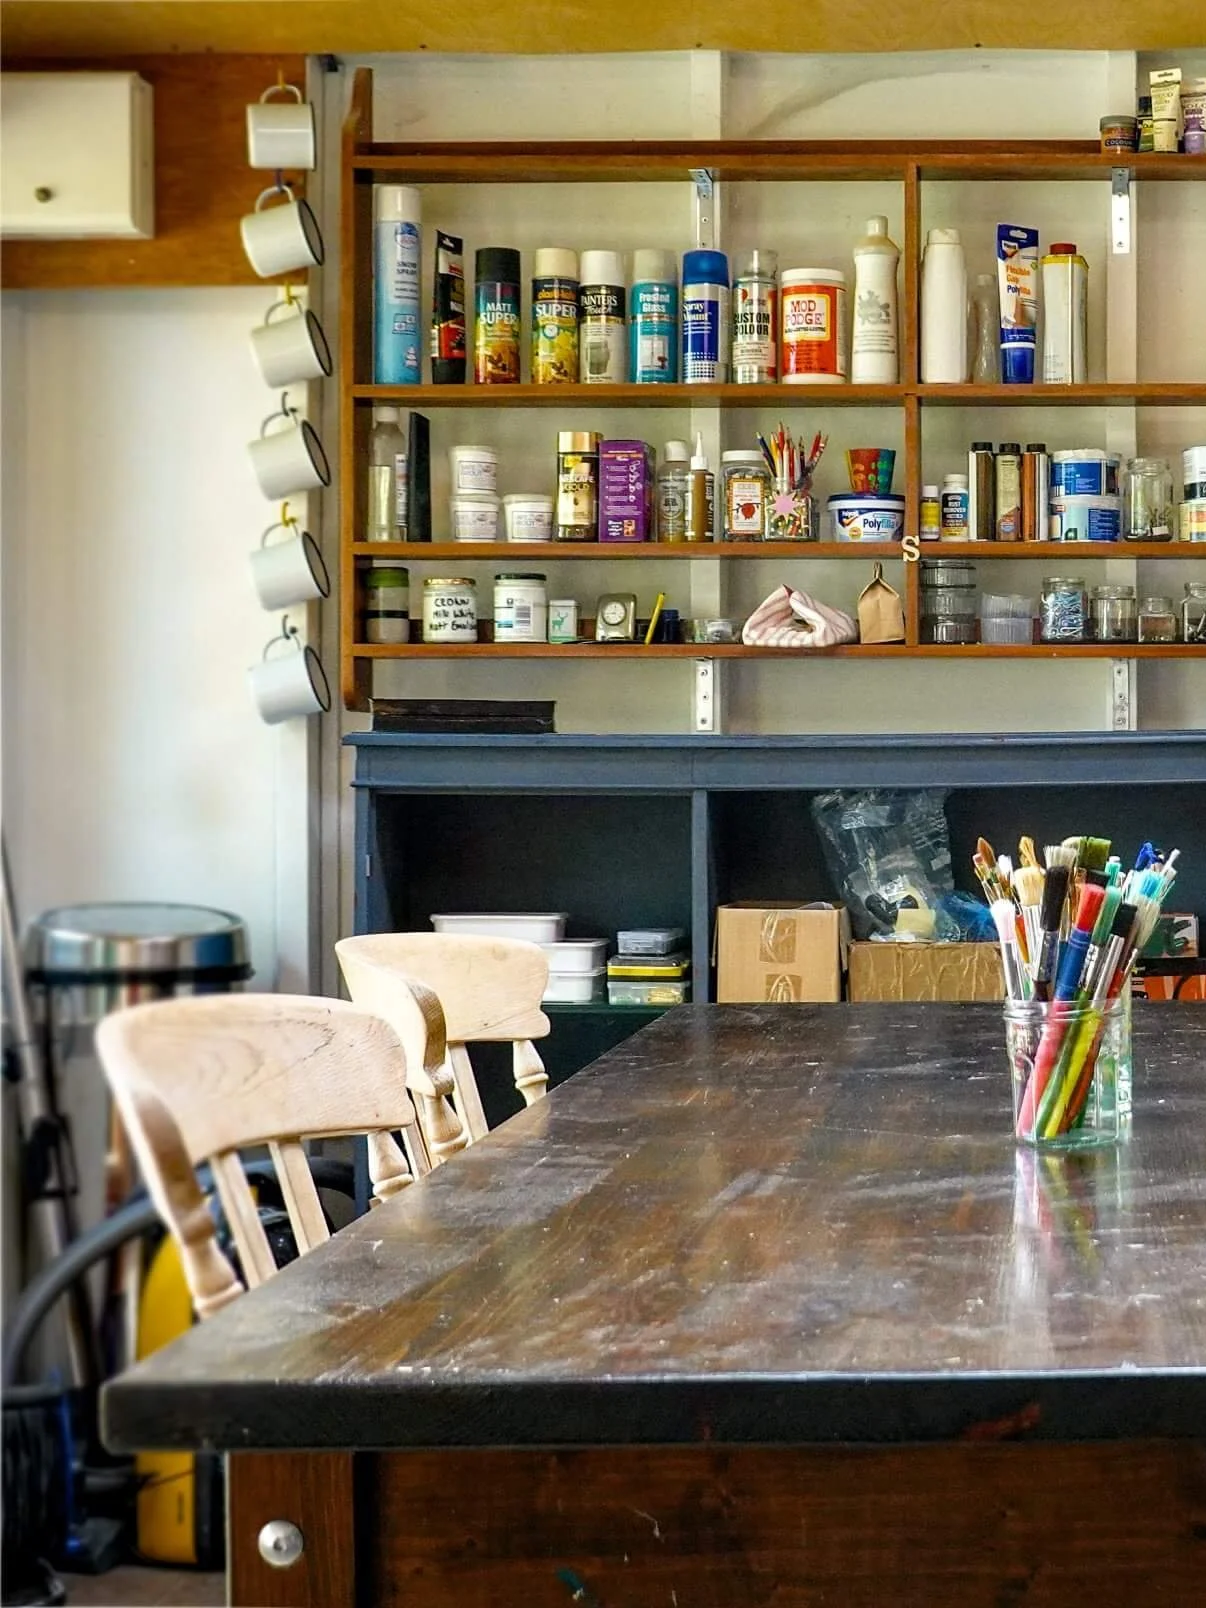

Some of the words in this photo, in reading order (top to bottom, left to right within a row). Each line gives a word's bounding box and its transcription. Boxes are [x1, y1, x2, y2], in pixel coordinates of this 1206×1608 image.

[486, 303, 512, 311] MATT
[536, 304, 577, 317] SUPER
[790, 300, 816, 312] MOD
[480, 313, 517, 324] SUPER
[734, 313, 770, 325] CUSTOM
[786, 313, 823, 325] PODGE
[734, 324, 769, 336] COLOUR
[902, 535, 920, 562] S
